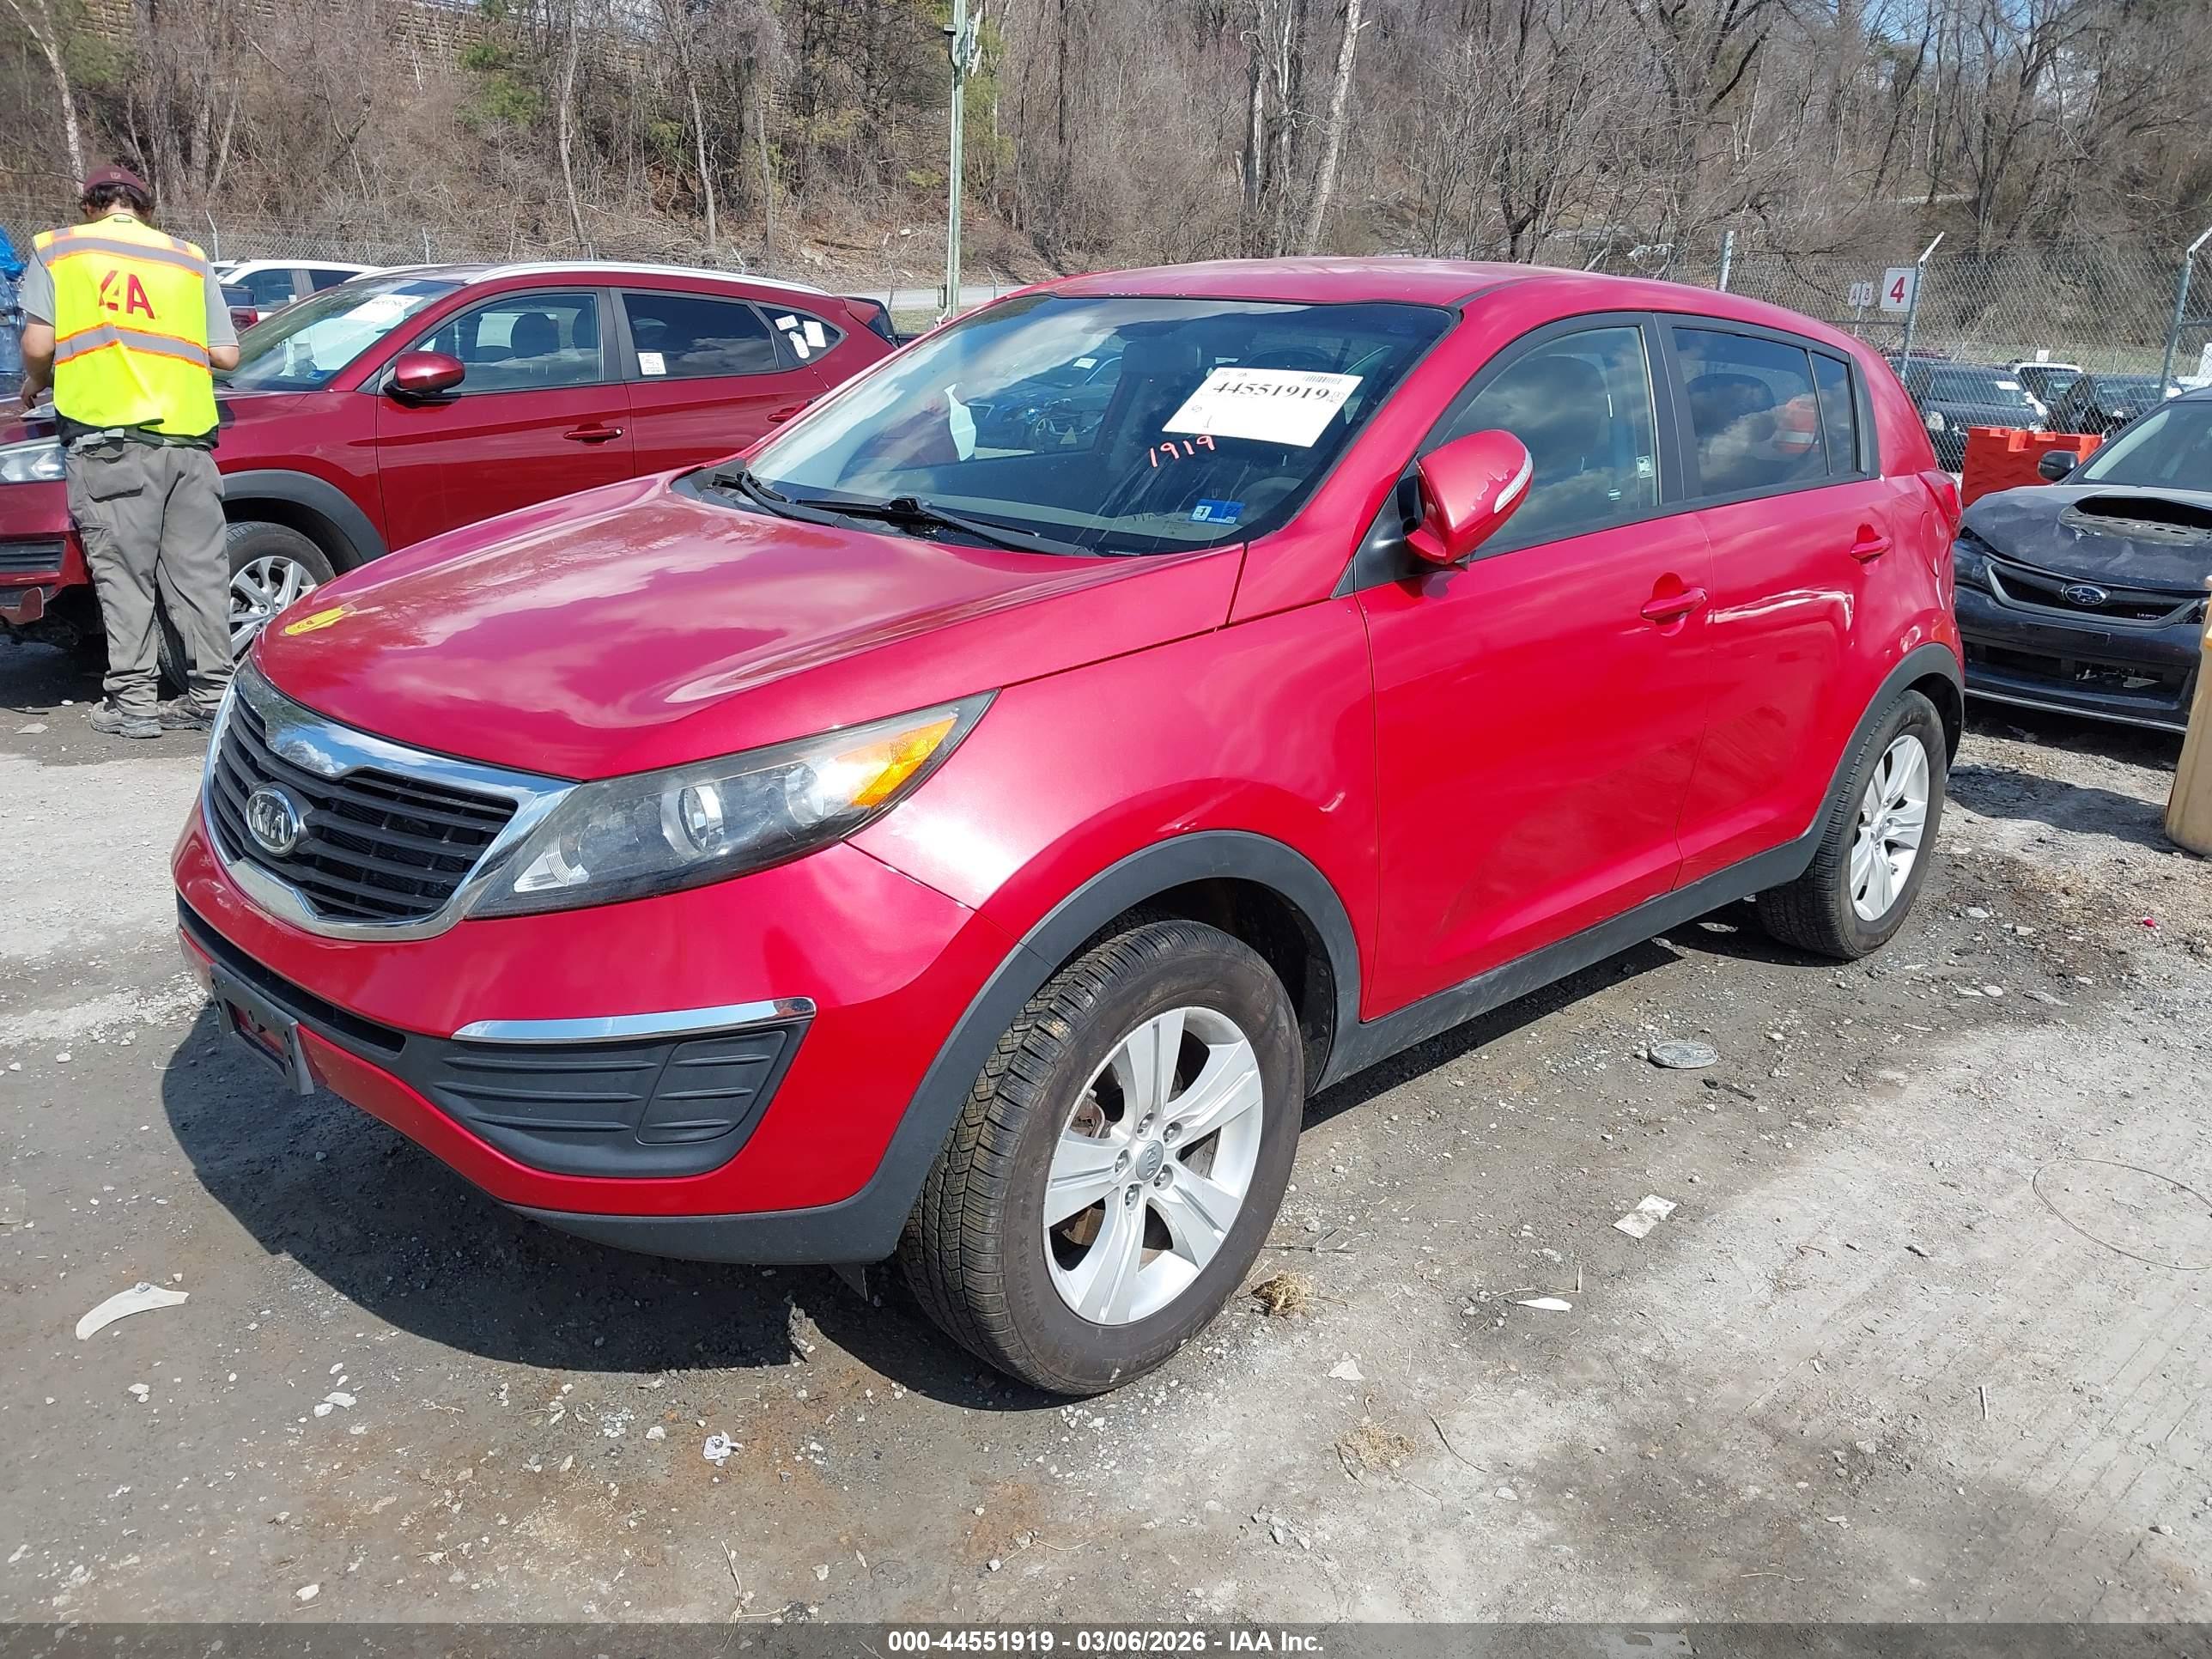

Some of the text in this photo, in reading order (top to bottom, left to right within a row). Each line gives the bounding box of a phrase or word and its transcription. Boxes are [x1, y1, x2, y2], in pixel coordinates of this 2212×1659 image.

[1889, 276, 1905, 304] 4
[1212, 381, 1330, 401] 44551919
[1150, 434, 1216, 468] 1919
